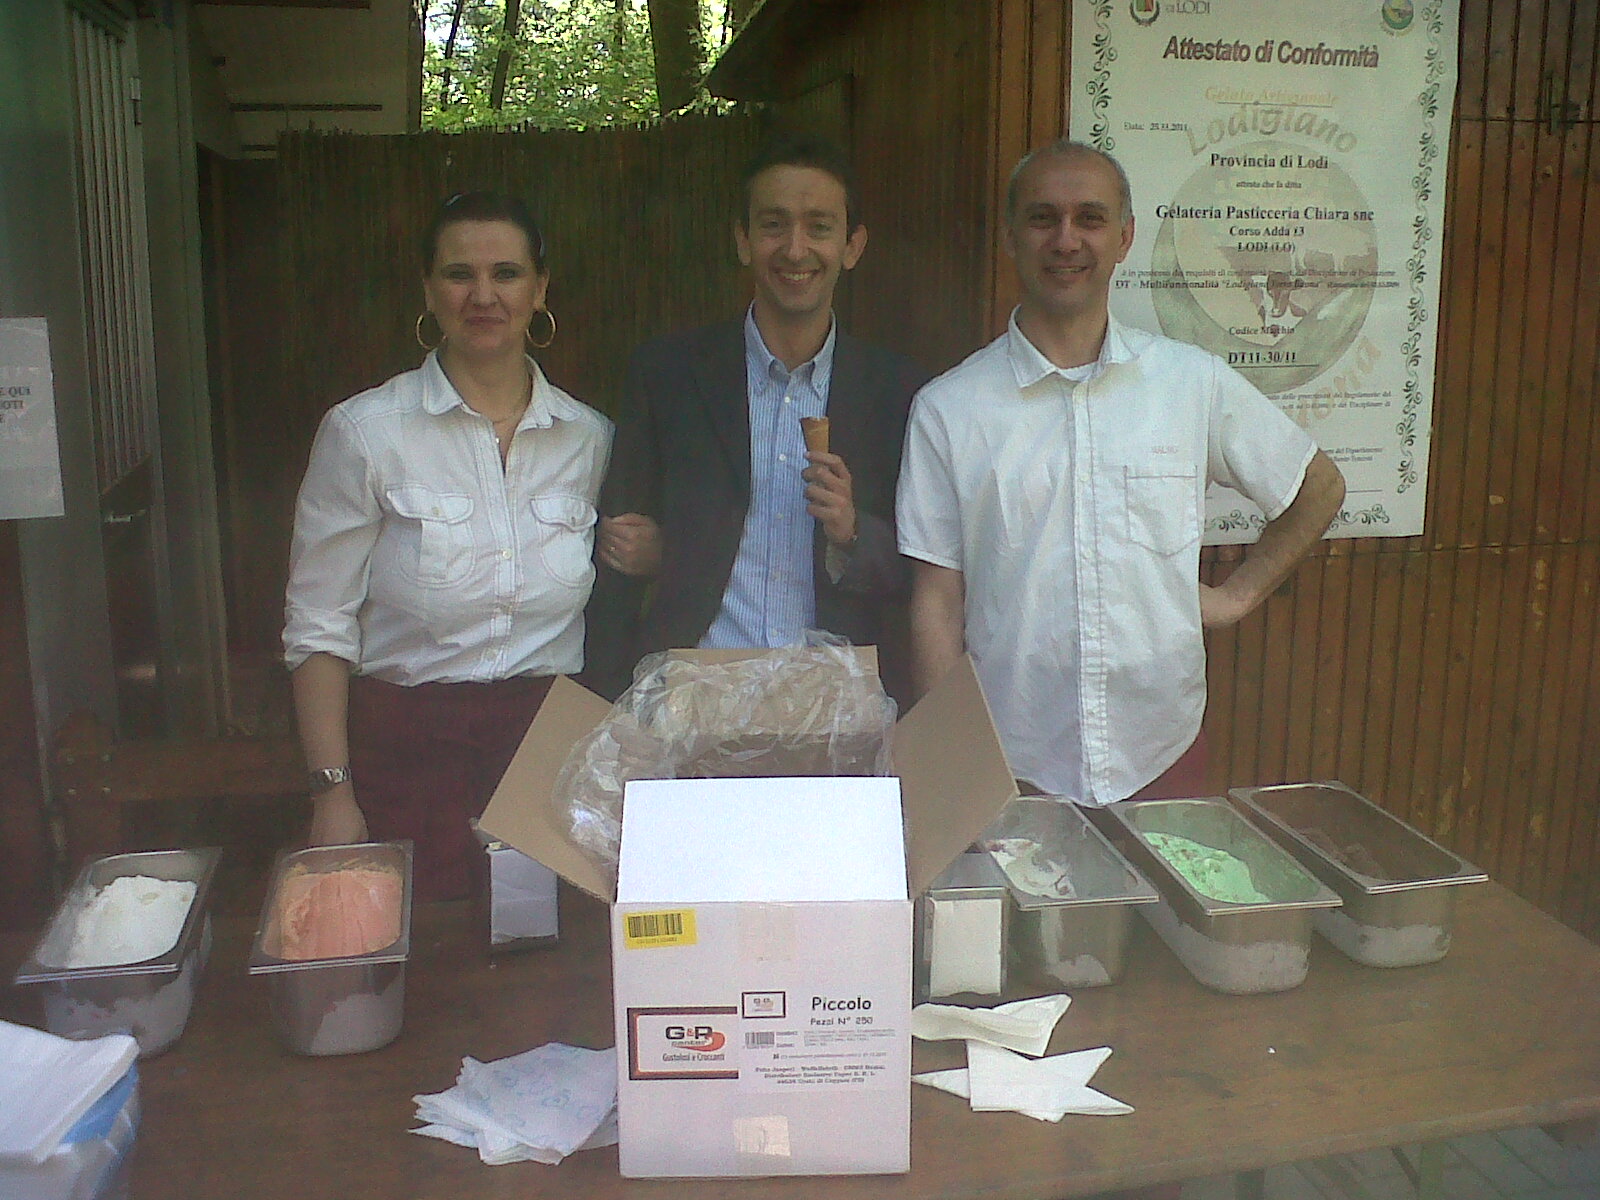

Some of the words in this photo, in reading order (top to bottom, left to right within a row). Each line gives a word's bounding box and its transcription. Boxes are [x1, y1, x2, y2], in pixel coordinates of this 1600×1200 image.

[1163, 35, 1251, 61] Attestato
[1254, 39, 1275, 62] di
[1277, 40, 1380, 68] Conformità
[1186, 103, 1358, 156] Lodigiano
[1210, 153, 1276, 168] Provincia
[1280, 155, 1293, 168] di
[1297, 155, 1328, 169] Lodi
[1156, 205, 1221, 219] Gelateria
[1226, 206, 1299, 219] Pasticceria
[1304, 206, 1349, 220] Chiara
[1229, 226, 1261, 236] Corso
[1263, 227, 1290, 237] Adda
[1238, 242, 1268, 252] LODI
[1229, 326, 1259, 335] Codice
[811, 996, 872, 1011] Piccolo
[810, 1018, 834, 1026] Pezzi
